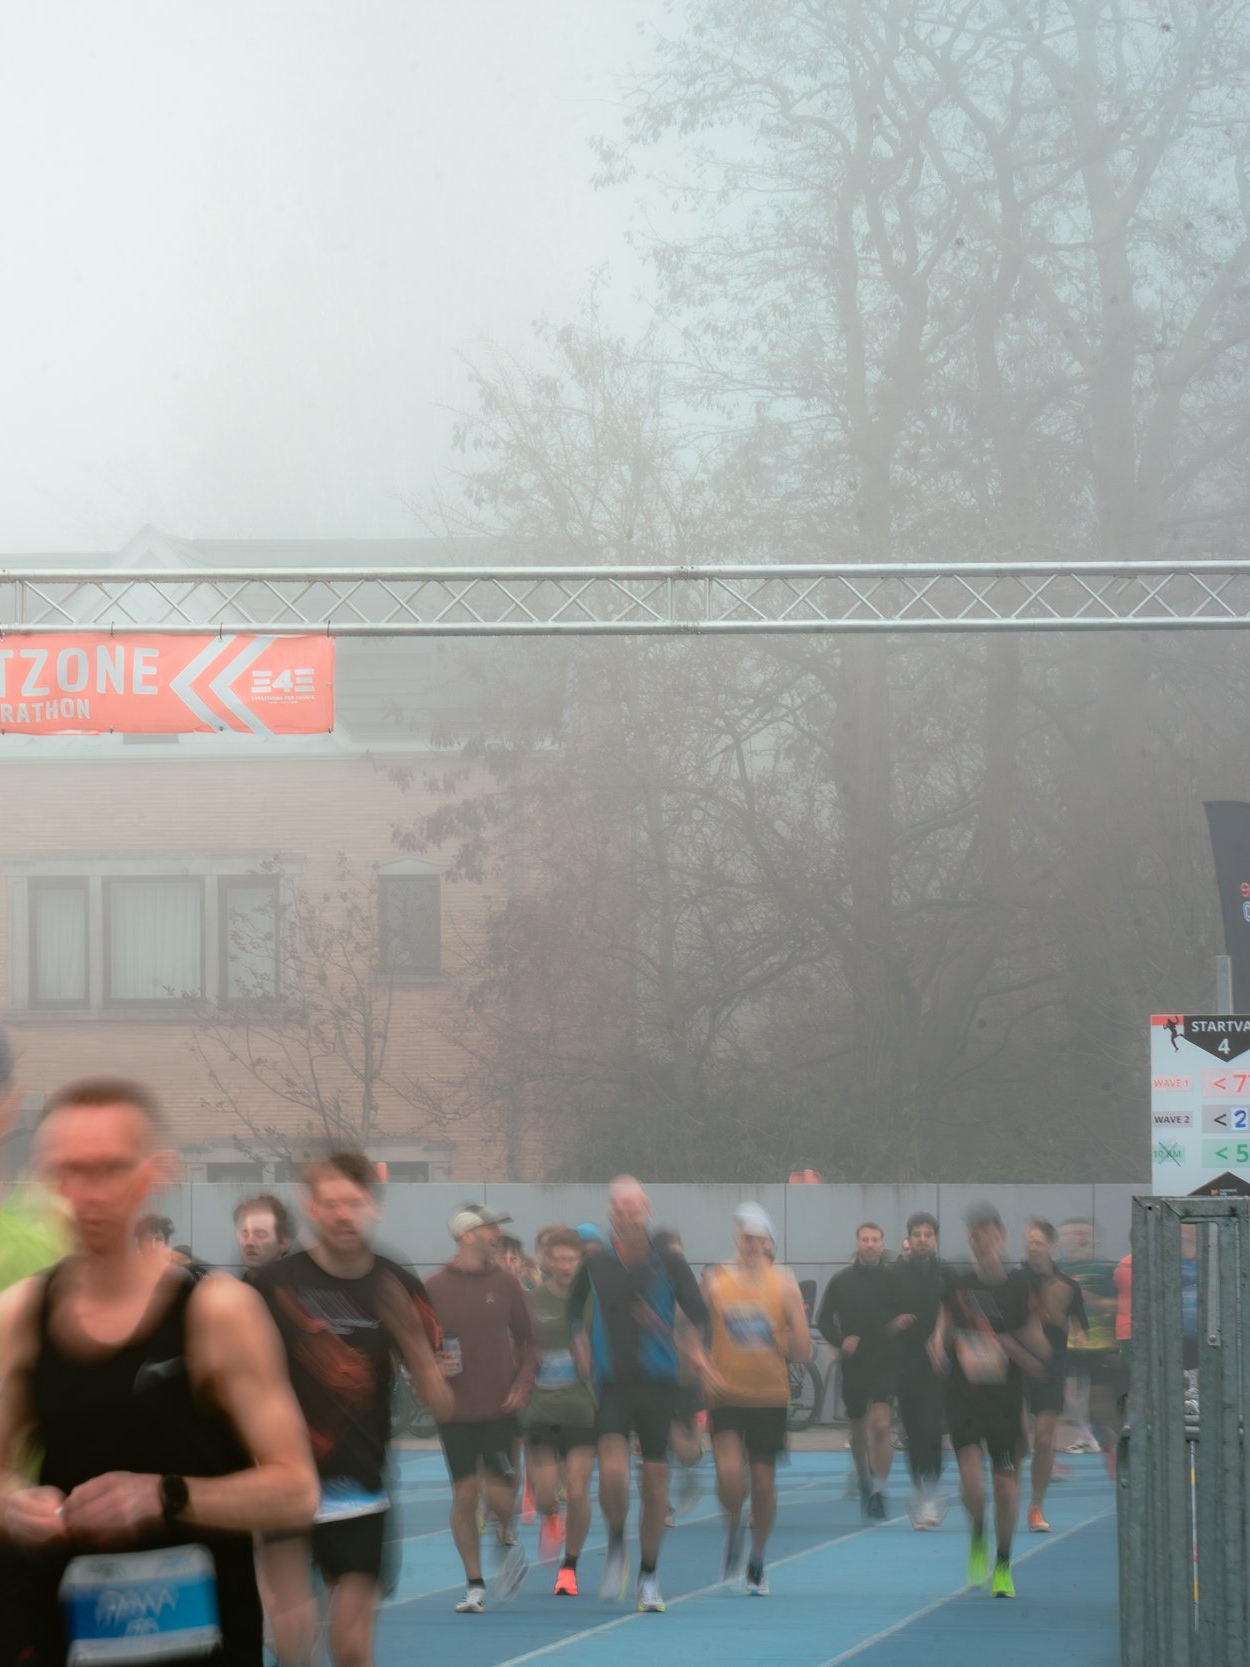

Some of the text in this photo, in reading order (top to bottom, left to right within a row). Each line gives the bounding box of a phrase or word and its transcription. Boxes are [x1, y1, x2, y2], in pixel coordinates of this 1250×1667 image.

[1217, 1038, 1230, 1055] 4
[1154, 1079, 1182, 1087] WAVE
[1233, 1073, 1250, 1093] 7
[1154, 1115, 1190, 1124] WAVE 2
